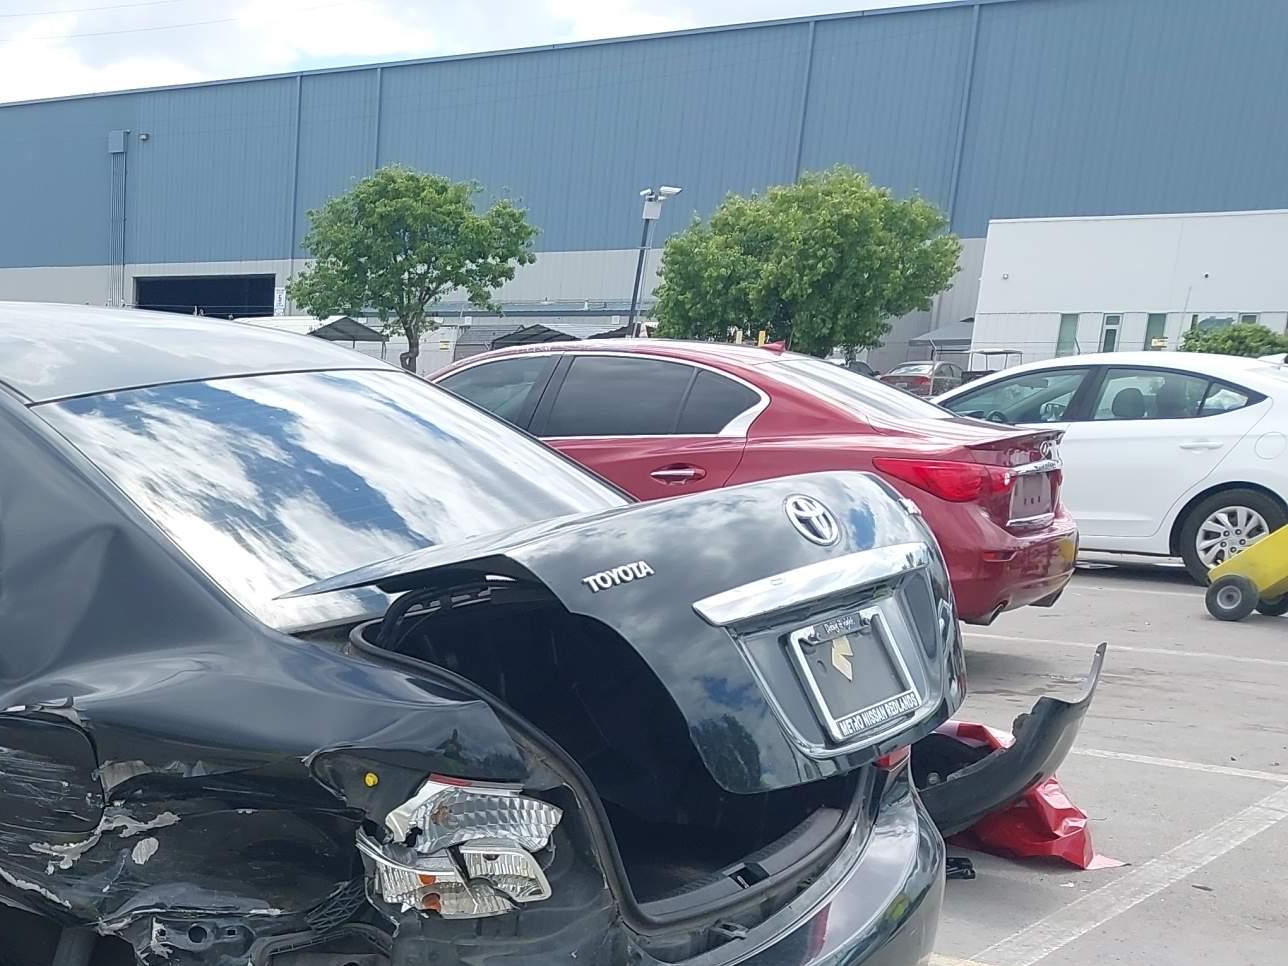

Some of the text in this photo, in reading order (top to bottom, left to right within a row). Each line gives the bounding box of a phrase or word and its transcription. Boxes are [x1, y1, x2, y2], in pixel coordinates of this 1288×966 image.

[583, 560, 655, 593] TOYOTA
[839, 693, 918, 736] METRO NISSAN REDLANDS
